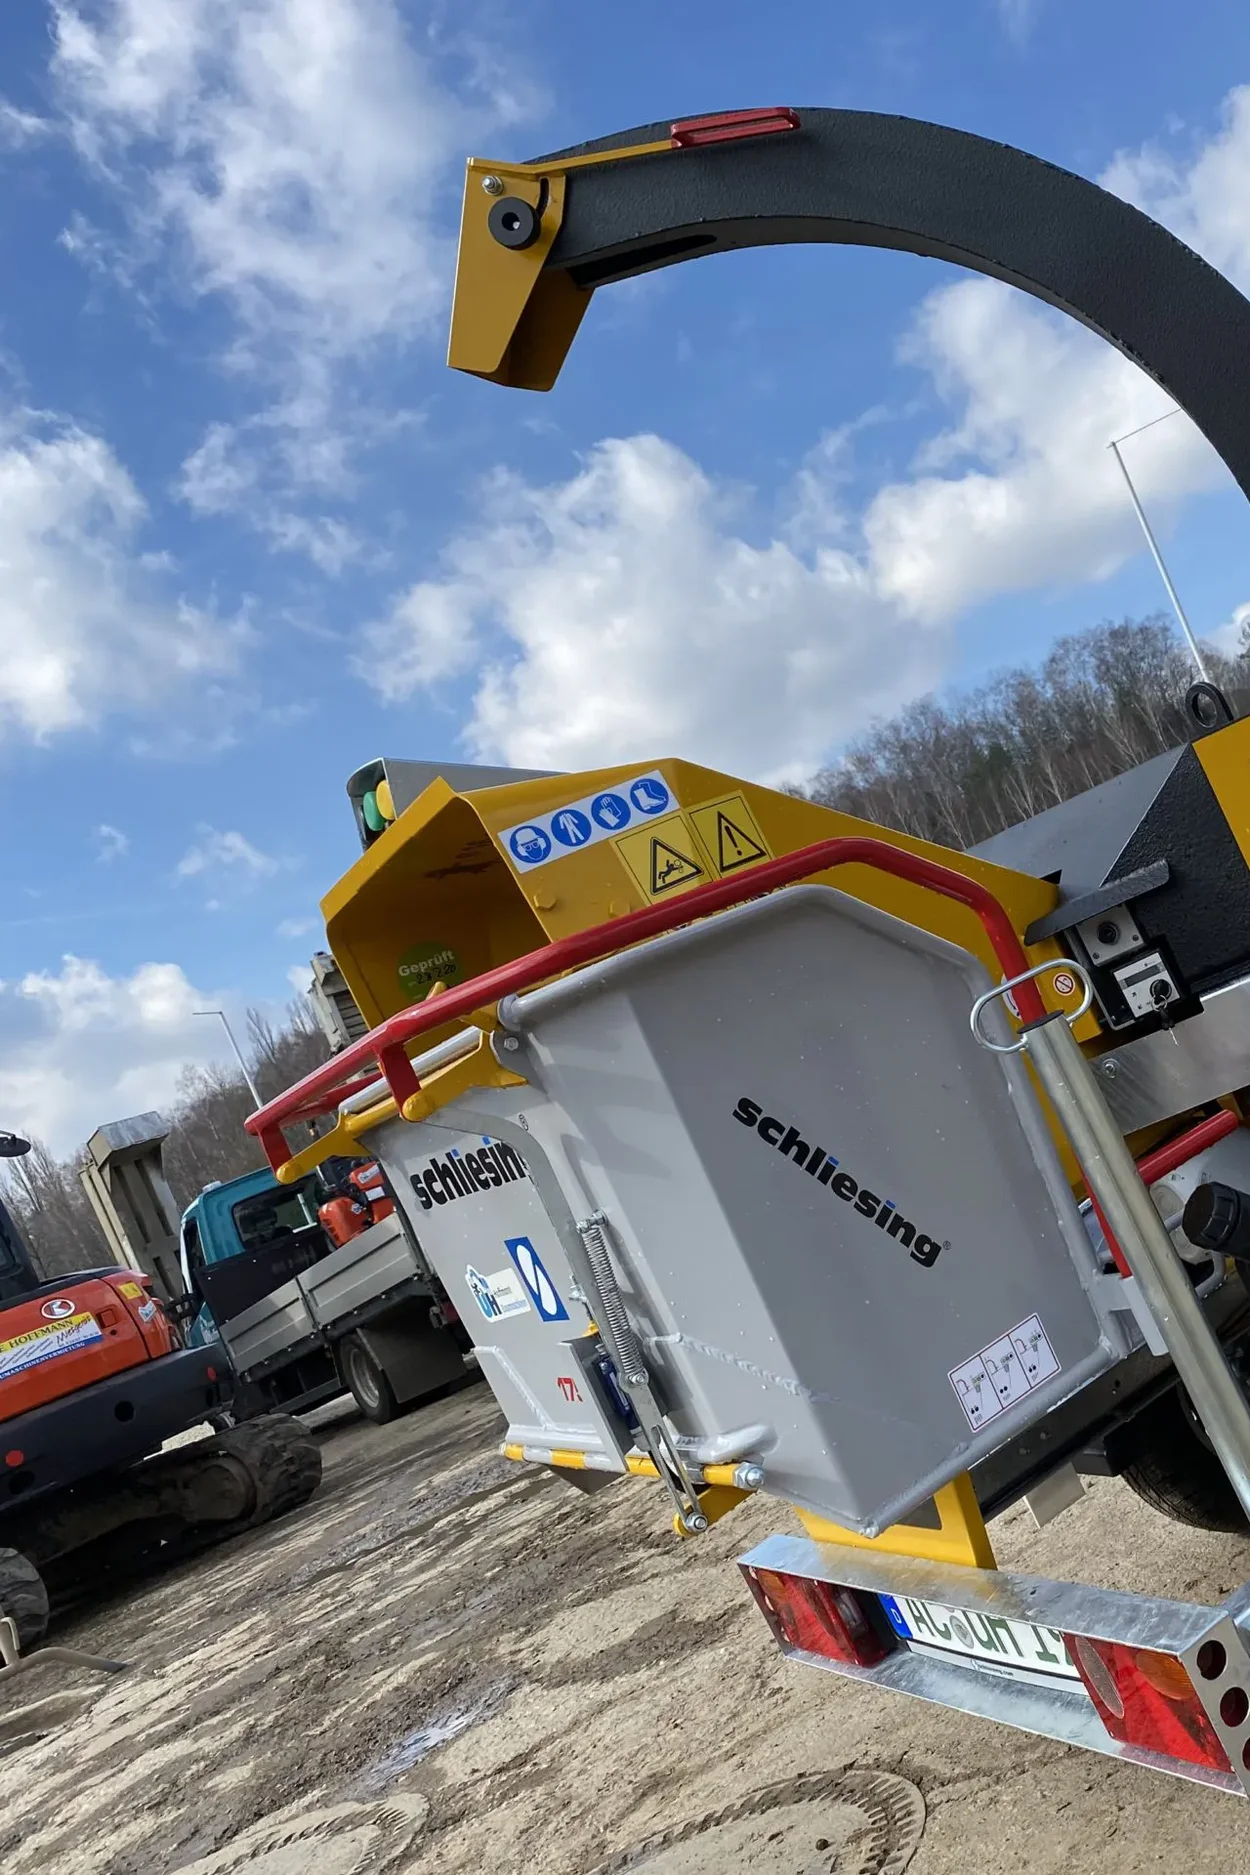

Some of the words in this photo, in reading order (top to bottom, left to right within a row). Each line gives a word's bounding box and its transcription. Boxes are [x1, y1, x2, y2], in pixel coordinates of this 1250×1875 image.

[399, 950, 454, 976] Geprüft
[409, 1136, 536, 1210] schliesin
[732, 1097, 942, 1268] schliesing
[9, 1319, 73, 1348] HOFFMANN
